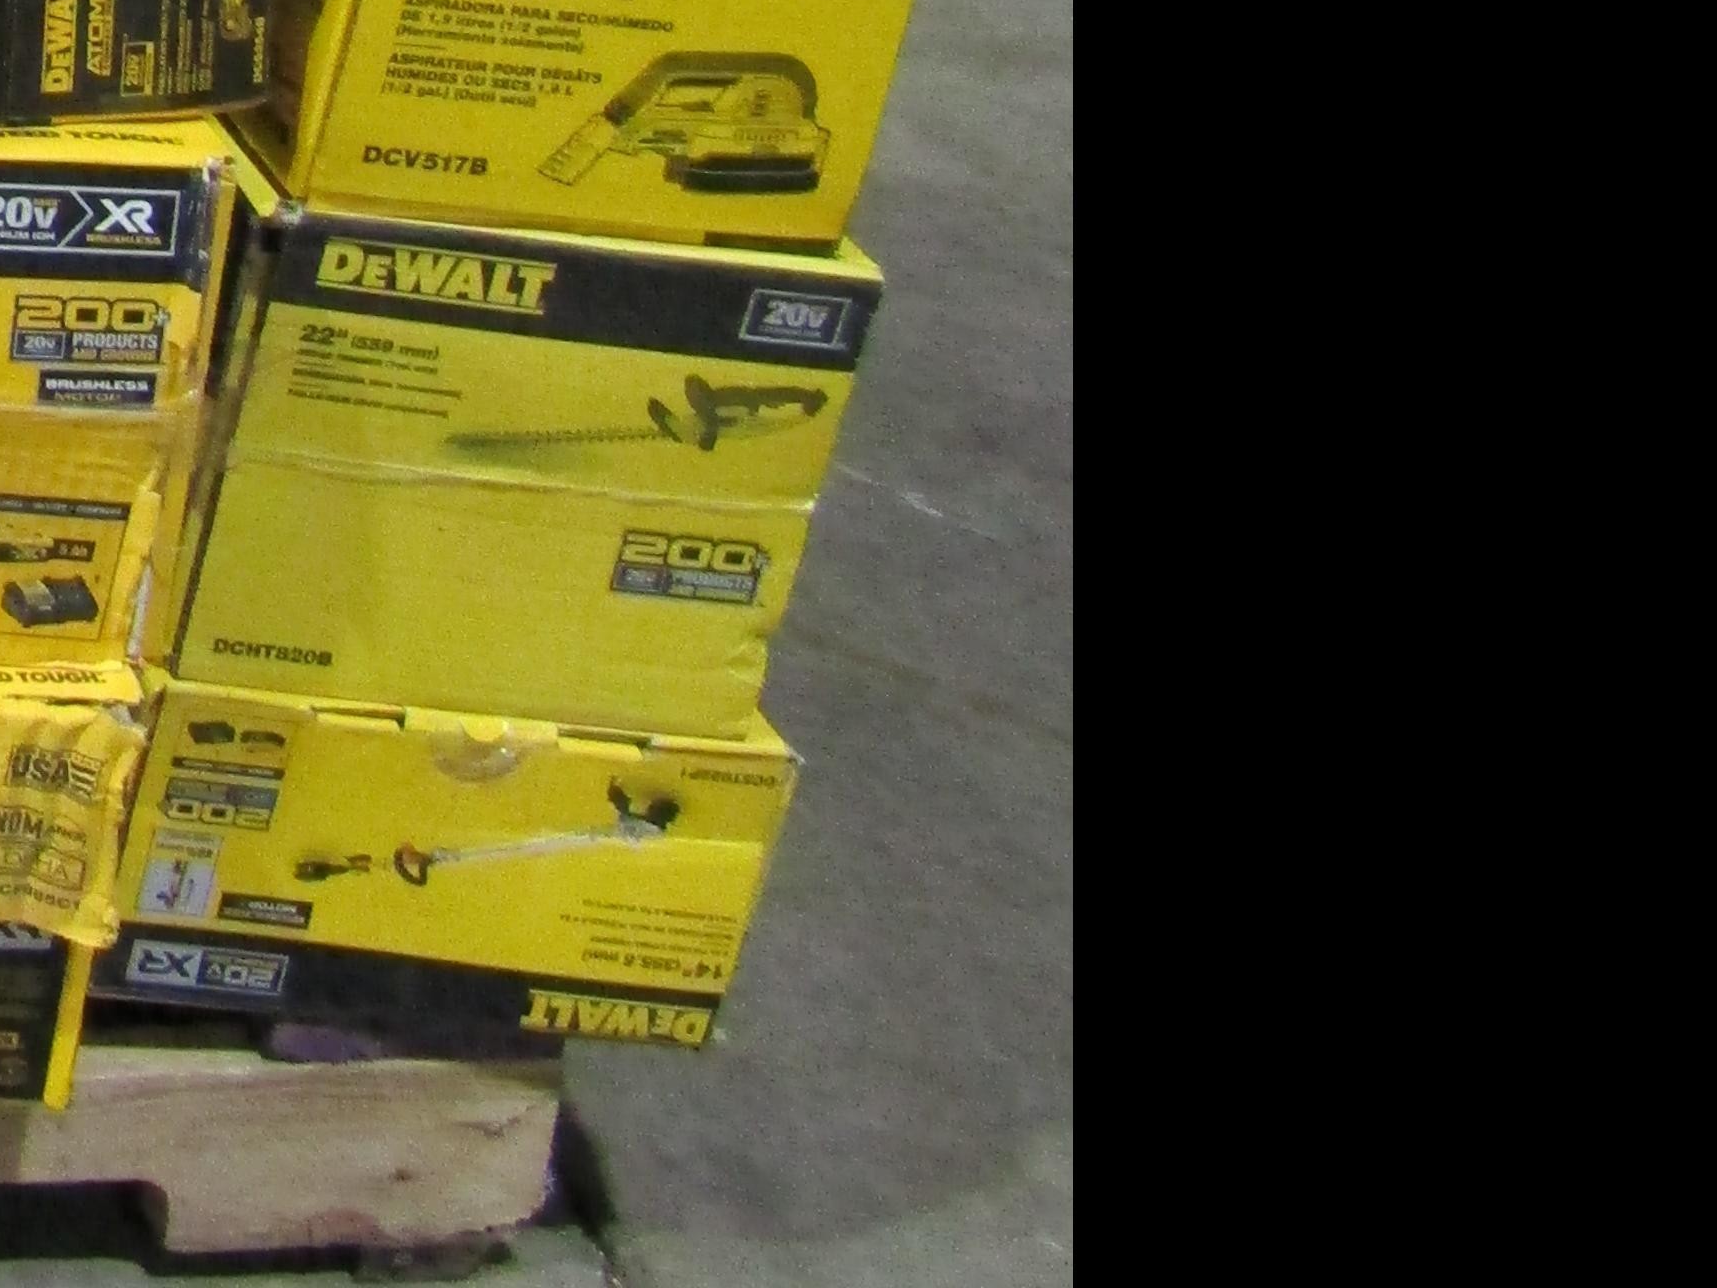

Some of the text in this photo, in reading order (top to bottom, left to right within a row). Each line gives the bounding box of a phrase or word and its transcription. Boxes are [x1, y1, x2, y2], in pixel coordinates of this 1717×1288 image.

[362, 145, 488, 176] DCV517B
[94, 199, 155, 234] XR
[317, 248, 555, 309] DEWALT
[73, 332, 158, 349] PRODUCTS
[45, 378, 149, 391] BRUSHLESS
[12, 750, 70, 785] USA
[137, 947, 194, 976] XR
[520, 992, 712, 1048] DEWALT
